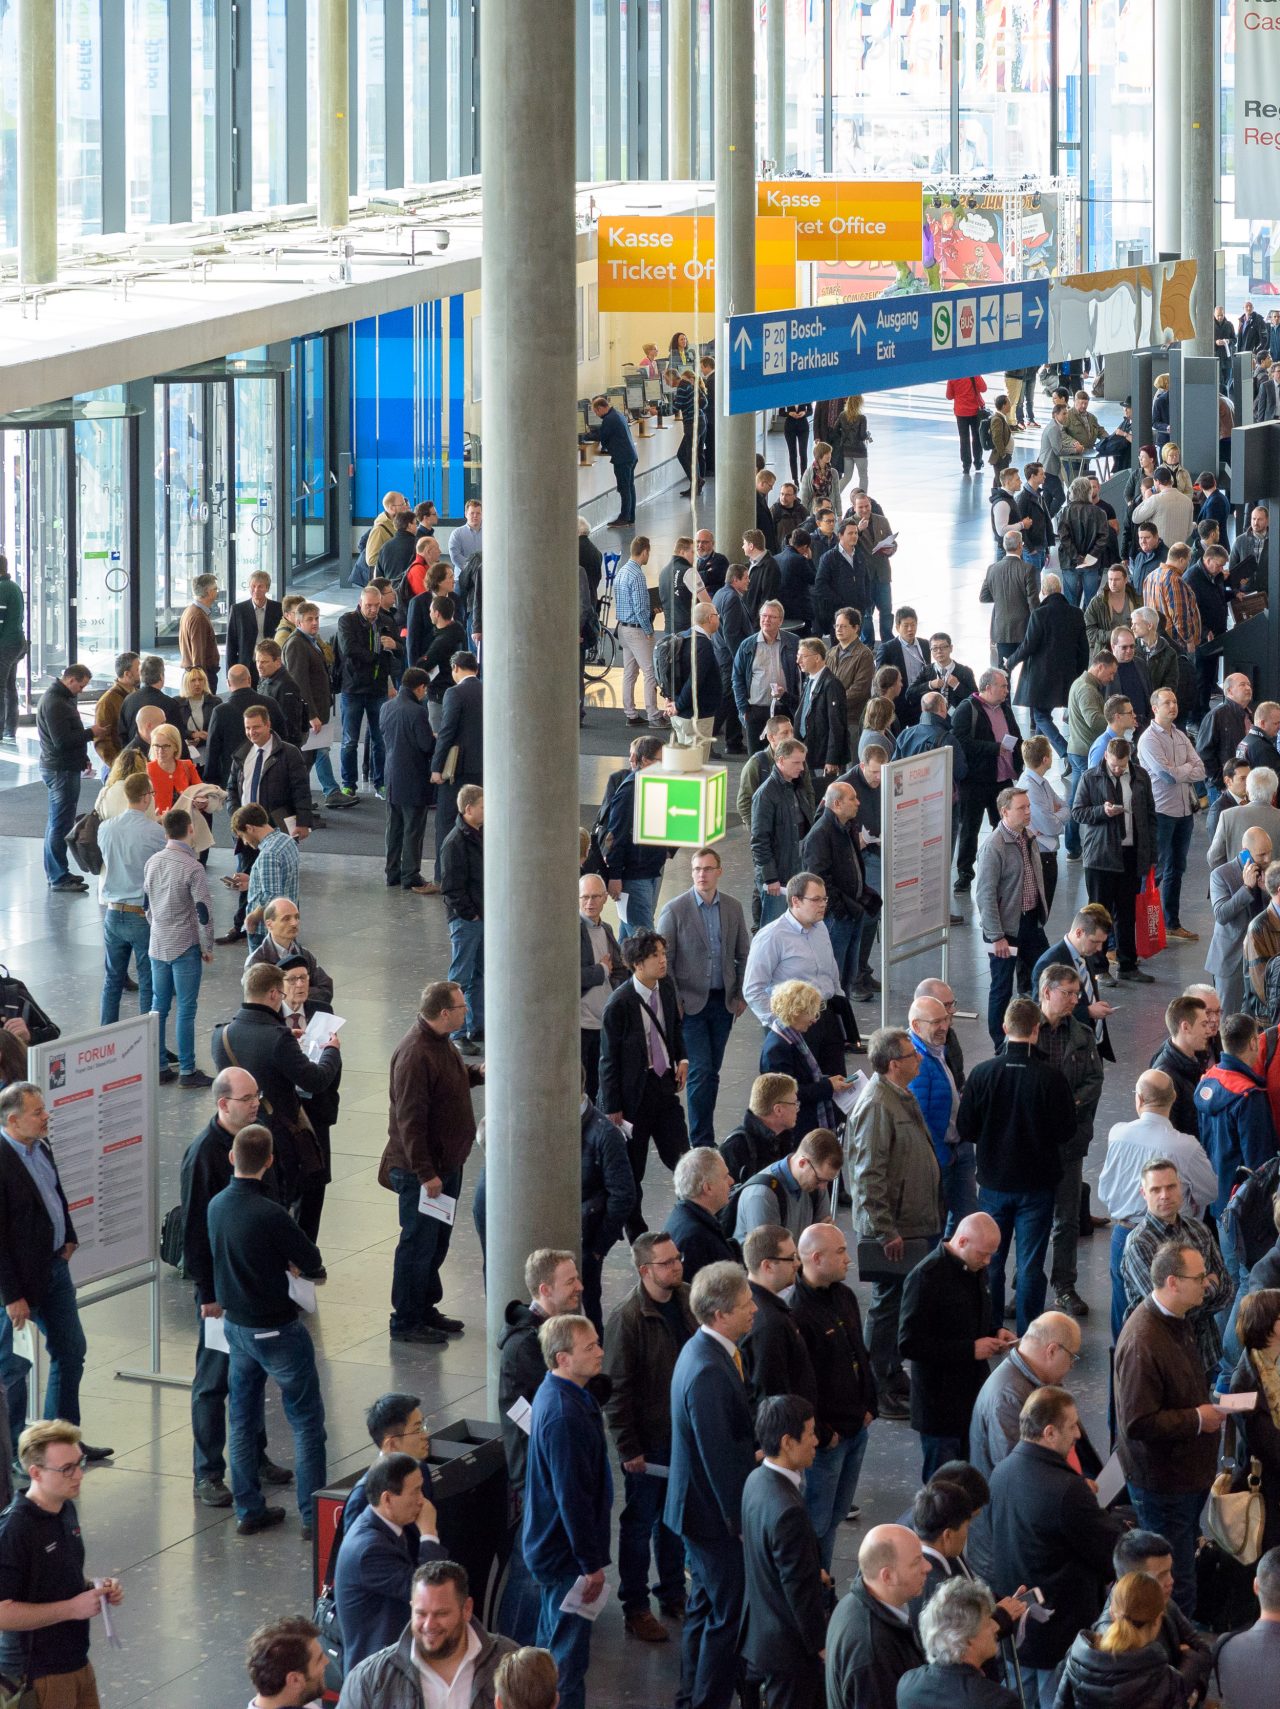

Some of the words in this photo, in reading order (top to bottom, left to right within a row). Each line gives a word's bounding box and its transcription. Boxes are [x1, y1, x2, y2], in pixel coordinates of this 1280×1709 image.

[767, 190, 821, 207] Kasse
[797, 217, 823, 234] ket
[829, 216, 887, 234] Office
[608, 226, 674, 248] Kasse
[607, 259, 676, 280] Ticket
[790, 316, 826, 341] Bosch-
[876, 309, 919, 331] Ausgang
[959, 316, 975, 331] BUS
[764, 330, 771, 346] P
[774, 328, 785, 345] 20
[764, 353, 771, 369] P
[774, 351, 785, 368] 21
[790, 349, 839, 372] Parkhaus
[876, 343, 896, 360] Exit
[909, 766, 930, 780] FORUM
[78, 1042, 116, 1066] FORUM
